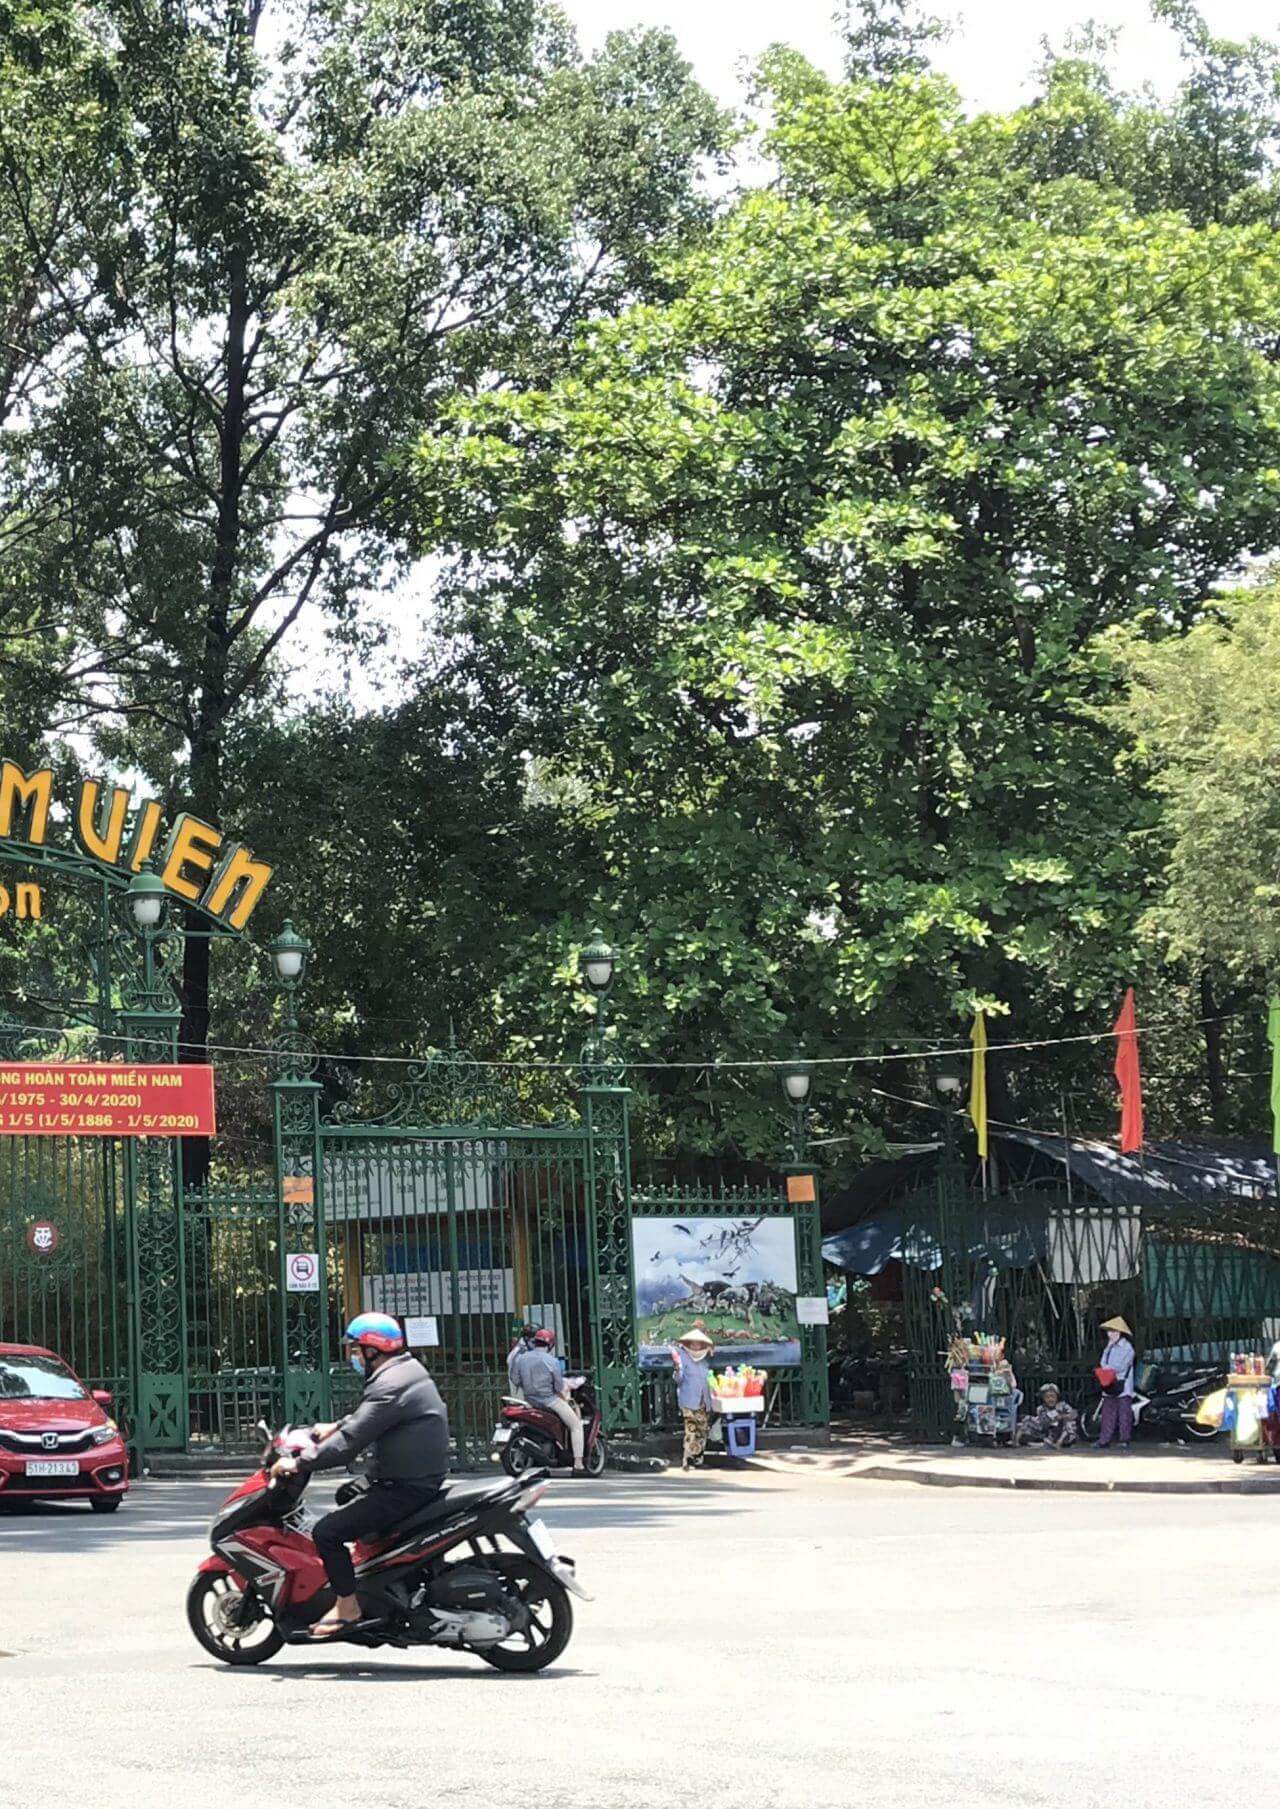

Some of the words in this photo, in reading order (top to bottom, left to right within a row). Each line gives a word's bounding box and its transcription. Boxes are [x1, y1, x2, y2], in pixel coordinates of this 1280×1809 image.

[25, 1070, 64, 1085] HOÀN
[68, 1070, 106, 1086] TOÀN
[151, 1074, 182, 1087] NAM
[59, 1093, 142, 1108] 30/4/2020)
[9, 1113, 34, 1126] 1/5
[39, 1114, 113, 1128] (1/5/1886
[127, 1114, 199, 1129] 1/5/2020)
